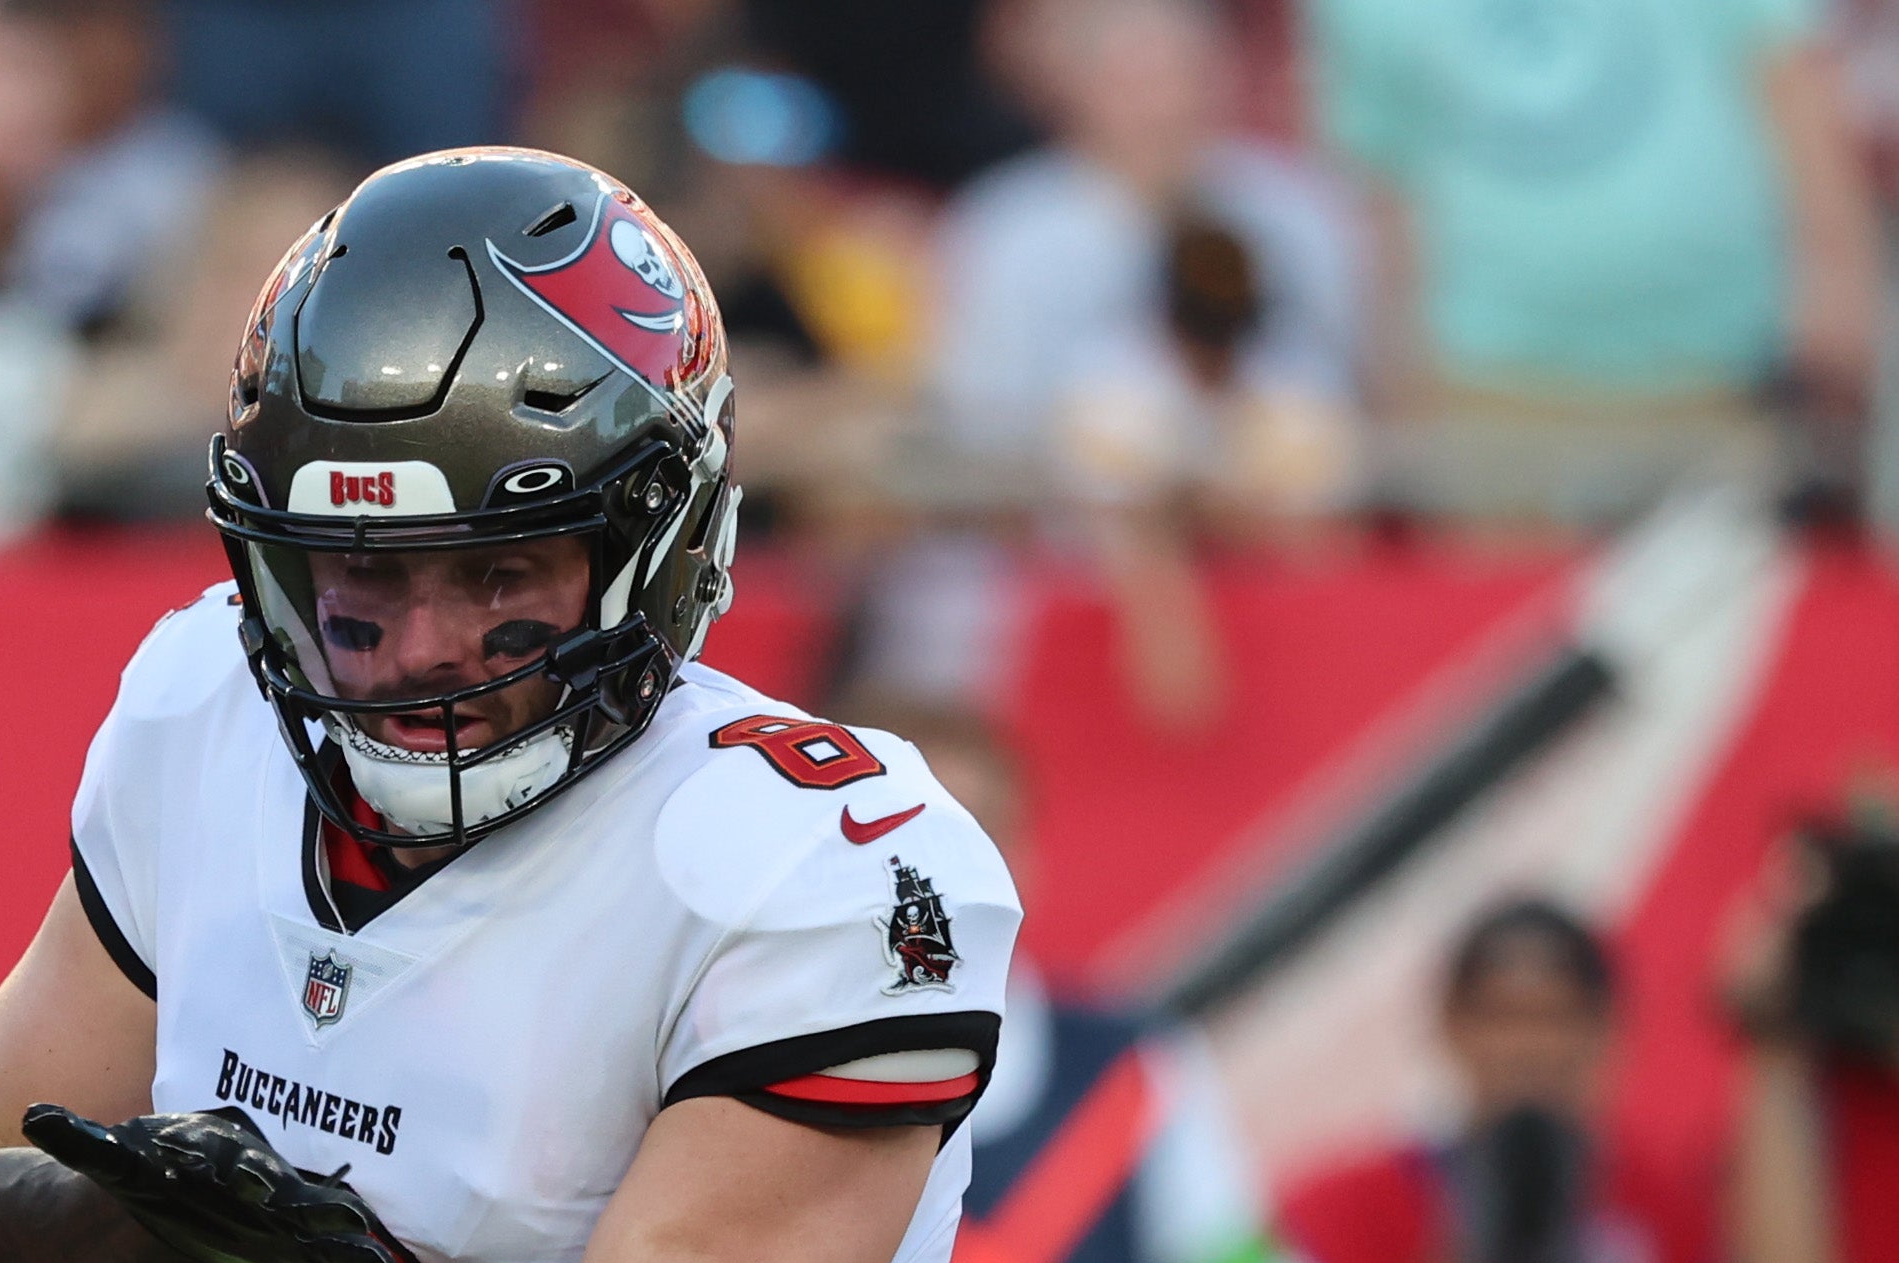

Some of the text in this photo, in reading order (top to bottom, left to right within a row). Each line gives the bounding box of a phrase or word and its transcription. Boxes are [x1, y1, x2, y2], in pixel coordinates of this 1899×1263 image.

[708, 713, 887, 790] 6
[306, 979, 337, 1015] NFL
[215, 1047, 402, 1156] BUCCANEERS
